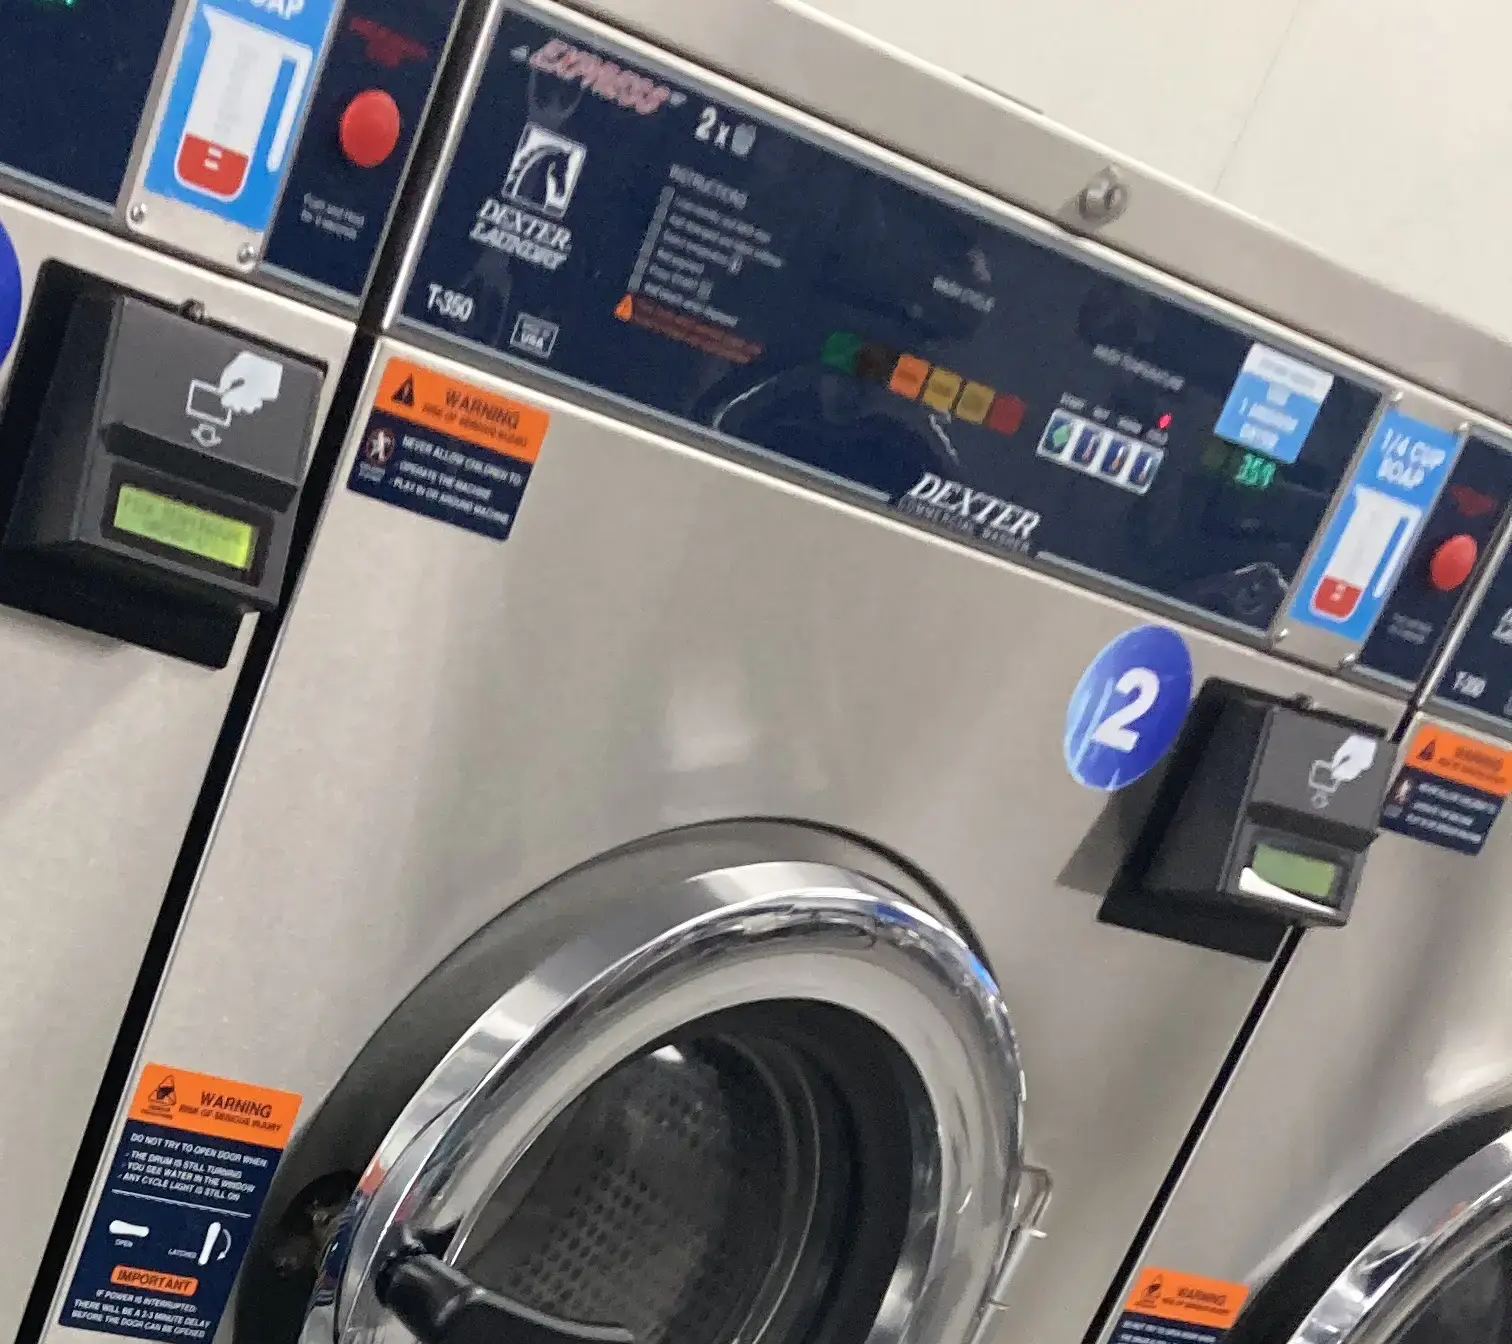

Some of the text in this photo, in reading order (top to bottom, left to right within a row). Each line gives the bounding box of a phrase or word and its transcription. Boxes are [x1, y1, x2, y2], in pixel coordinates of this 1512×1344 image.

[469, 221, 568, 270] LAUNDRY
[477, 199, 571, 251] DEXTER
[442, 386, 521, 429] WARNING
[908, 472, 1041, 539] DEXTER
[1092, 666, 1161, 754] 2
[198, 1090, 273, 1119] WARNING
[129, 1132, 146, 1143] DO
[144, 1135, 163, 1147] NOT
[163, 1139, 181, 1150] TRY
[180, 1142, 194, 1152] TO
[192, 1145, 217, 1157] OPEN
[216, 1150, 242, 1162] DOOR
[116, 1268, 191, 1293] IMPORTANT
